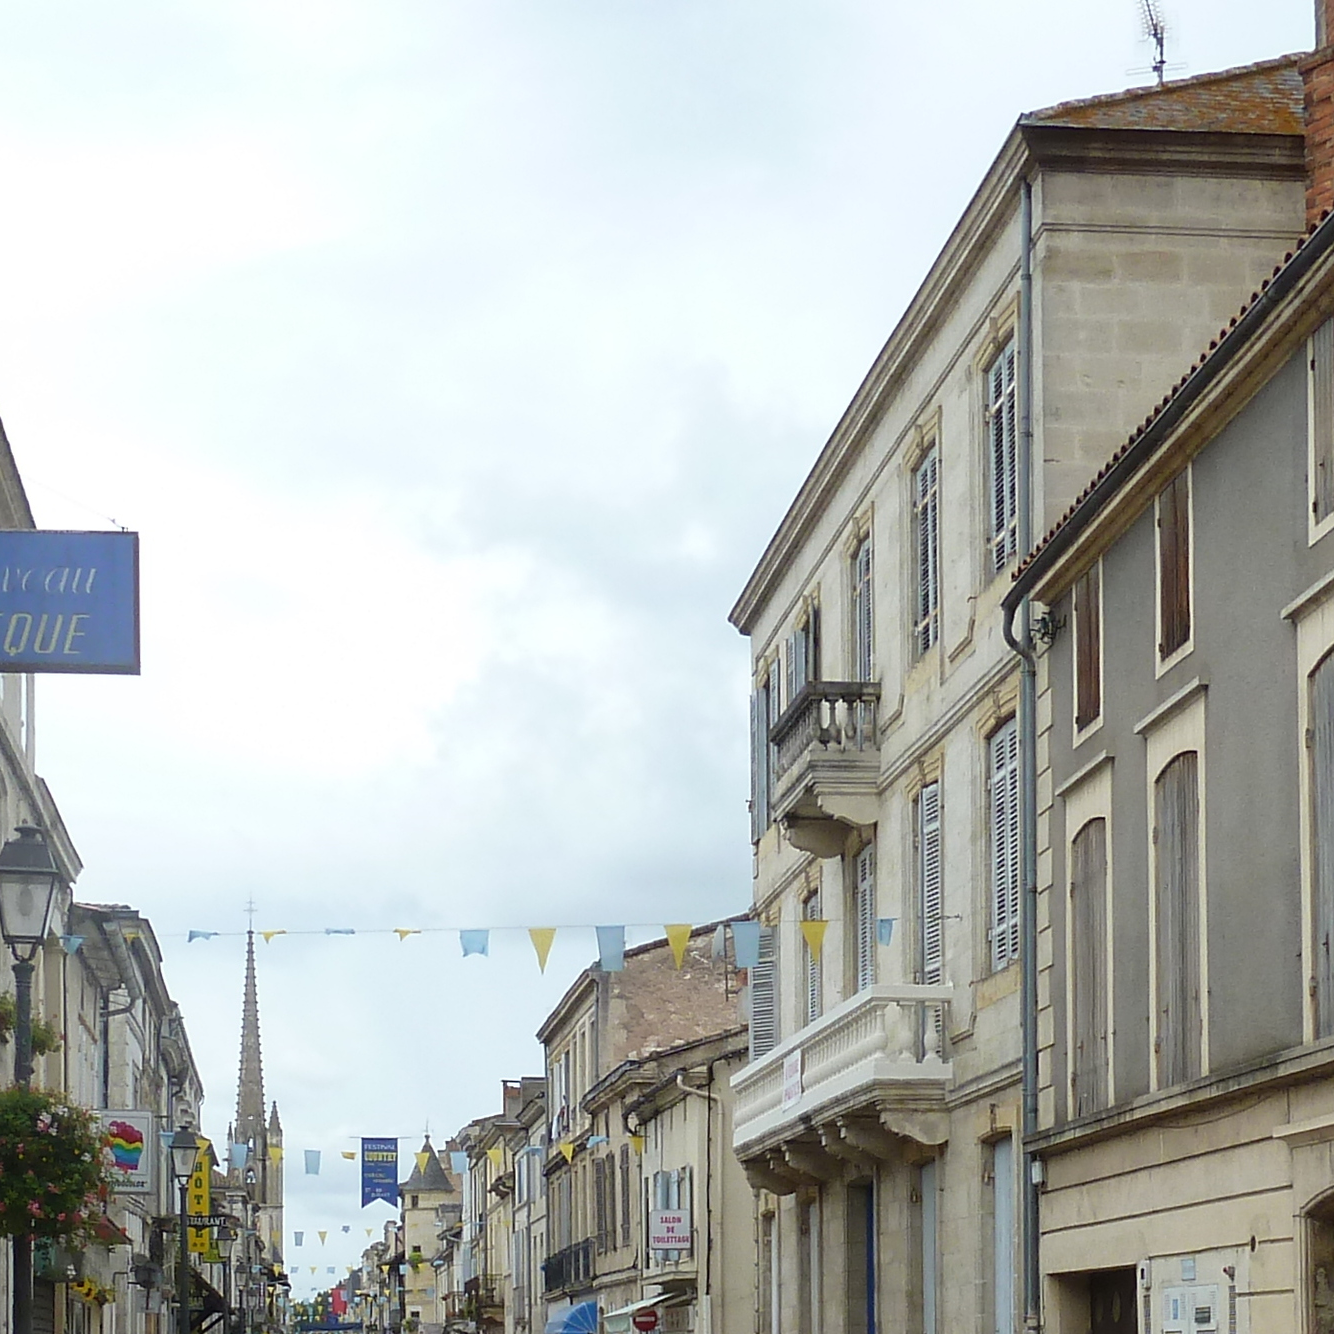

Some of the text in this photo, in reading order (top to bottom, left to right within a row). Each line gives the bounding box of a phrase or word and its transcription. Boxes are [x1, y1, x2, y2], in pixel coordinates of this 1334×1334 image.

[660, 1216, 682, 1224] SALON
[666, 1226, 675, 1234] DE
[652, 1235, 690, 1244] TOILETTAGE
